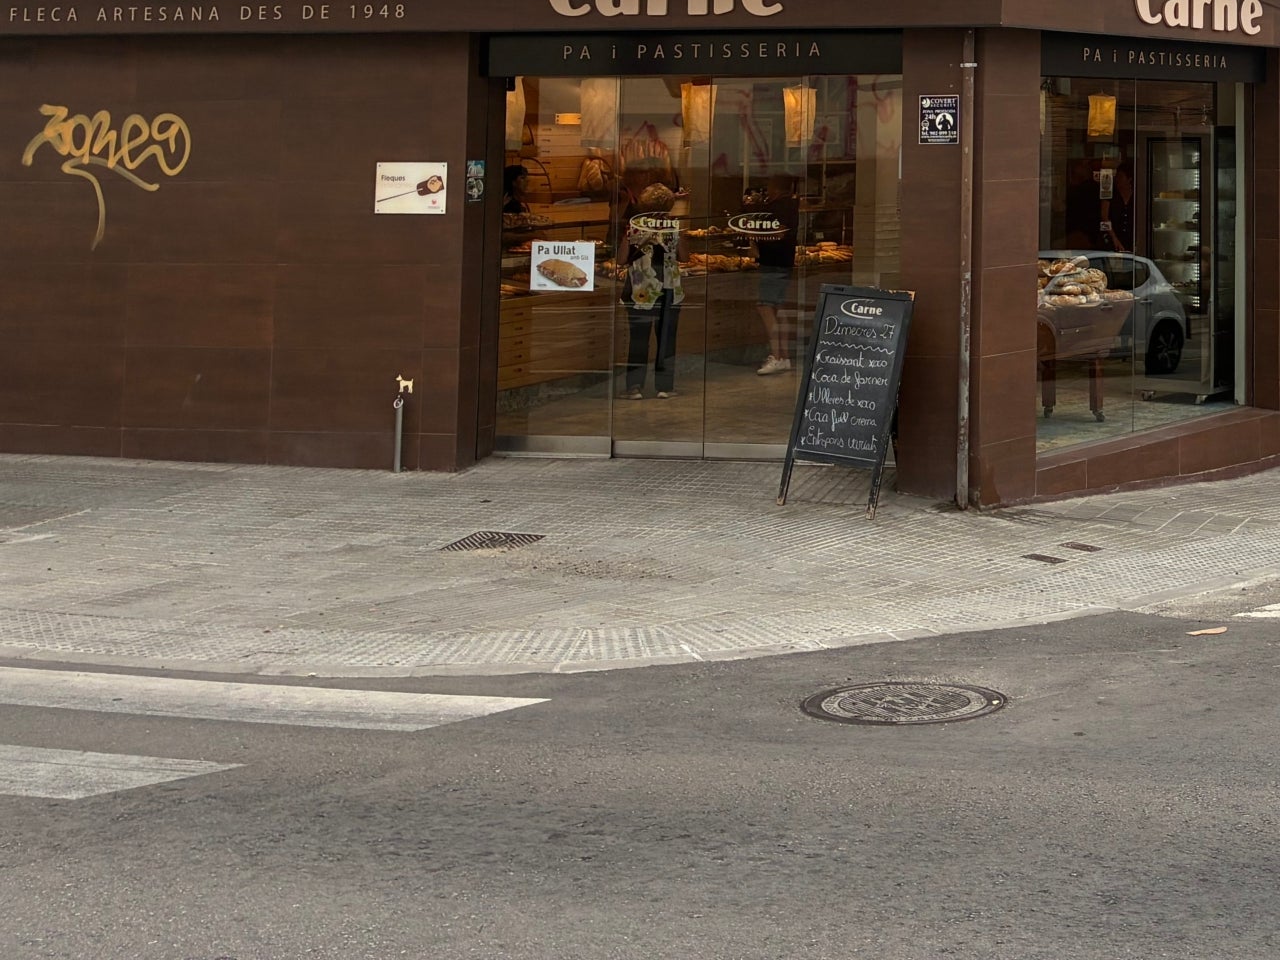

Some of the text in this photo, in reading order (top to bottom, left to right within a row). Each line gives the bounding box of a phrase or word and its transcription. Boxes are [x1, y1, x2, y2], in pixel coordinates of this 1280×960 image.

[9, 4, 406, 22] FLECA ARTESANA DES DE 1948
[562, 45, 591, 60] PA
[637, 42, 821, 59] PASTISSERIA
[1083, 48, 1102, 62] PA
[1128, 50, 1228, 69] PASTISSERIA
[640, 216, 680, 228] Carné
[738, 218, 781, 229] Carné
[537, 245, 576, 255] Pa Ullat
[824, 316, 896, 339] Dimecres 27
[840, 369, 851, 385] de
